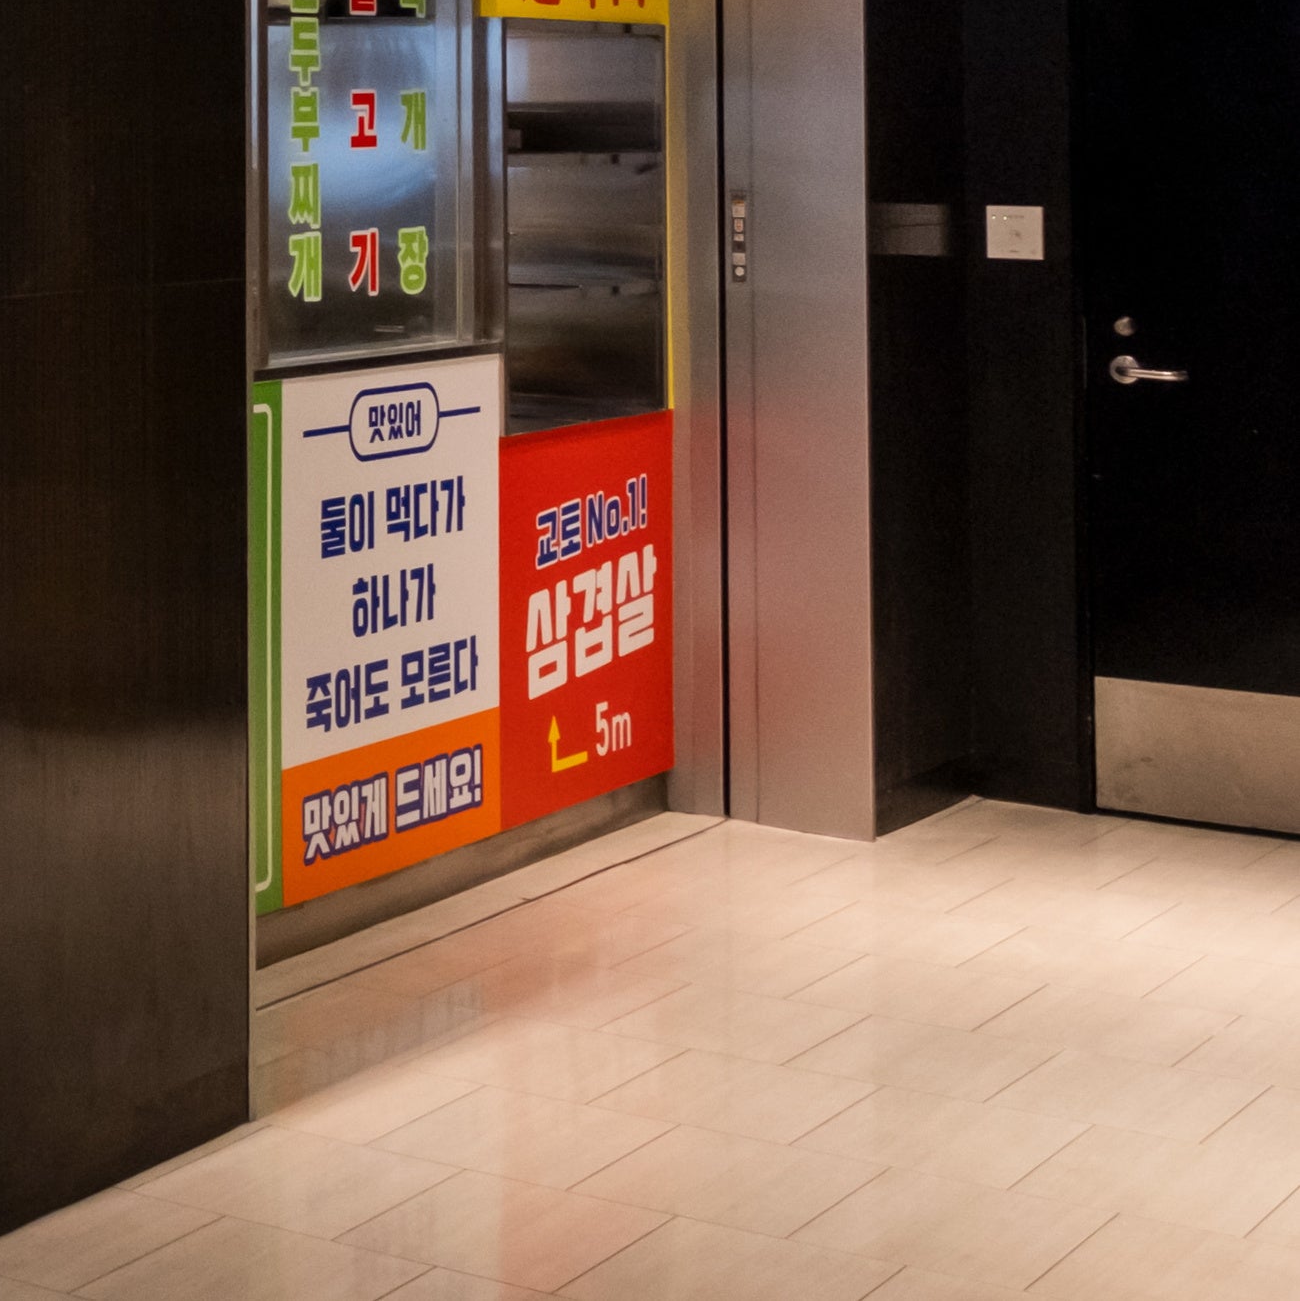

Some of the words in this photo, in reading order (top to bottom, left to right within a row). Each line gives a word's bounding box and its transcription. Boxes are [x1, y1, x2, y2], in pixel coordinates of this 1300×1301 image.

[368, 400, 421, 443] 맛있어
[320, 491, 375, 559] 둘이
[386, 475, 466, 542] 먹다가
[536, 497, 581, 569] 교토
[587, 474, 648, 549] No.1!
[352, 563, 436, 637] 하나가
[525, 544, 656, 700] 삼겹살
[306, 658, 389, 733] 죽어도
[401, 635, 479, 709] 모른다
[595, 701, 632, 758] 5m
[304, 772, 388, 866] 맛있게
[395, 743, 483, 834] 드세요!
